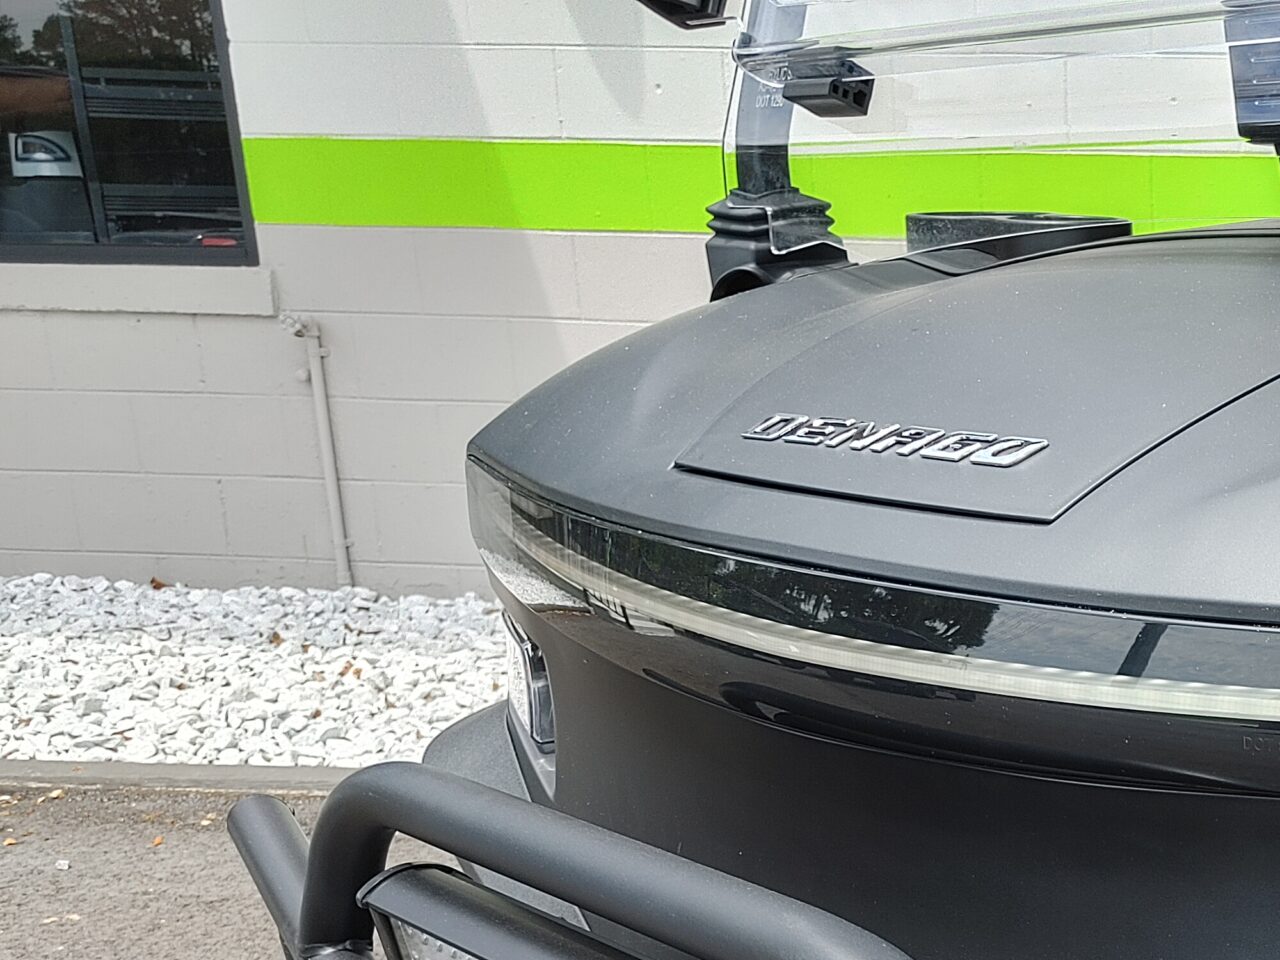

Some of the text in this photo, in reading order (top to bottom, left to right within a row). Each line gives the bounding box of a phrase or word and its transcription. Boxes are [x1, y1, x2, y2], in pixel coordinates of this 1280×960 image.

[755, 94, 770, 108] DOT
[741, 412, 1050, 468] DENAGO
[1242, 736, 1274, 752] DOT
